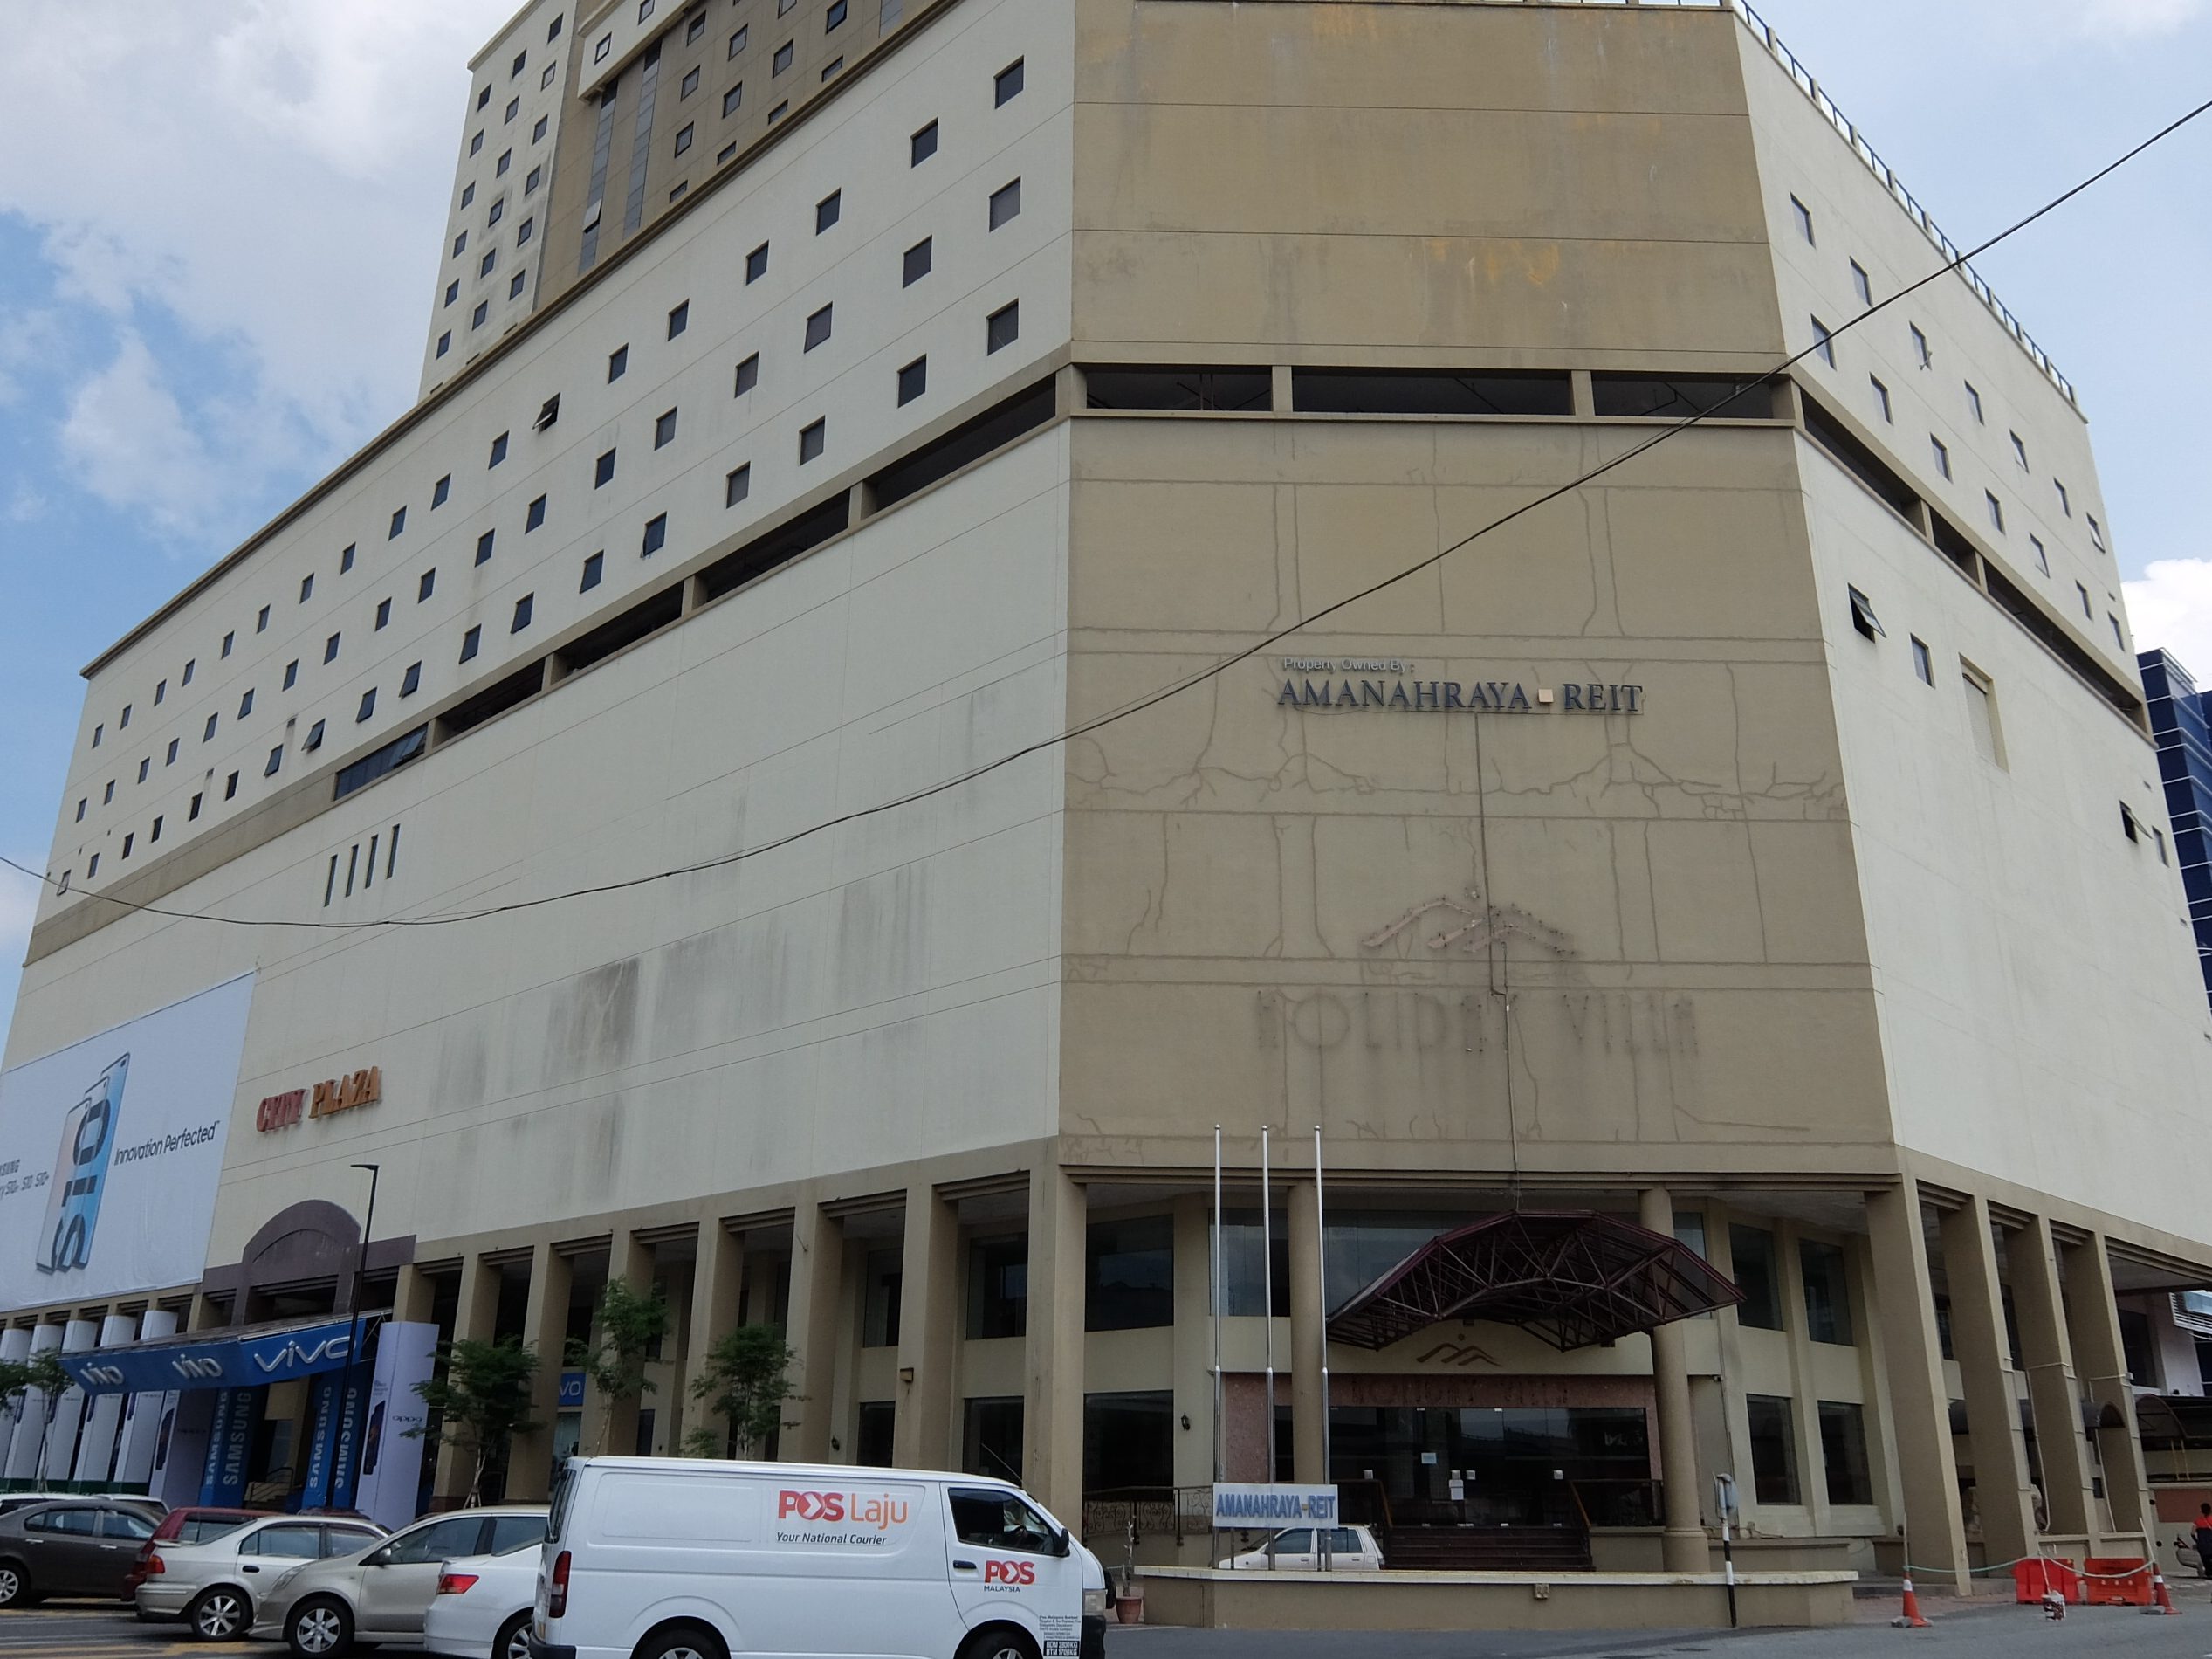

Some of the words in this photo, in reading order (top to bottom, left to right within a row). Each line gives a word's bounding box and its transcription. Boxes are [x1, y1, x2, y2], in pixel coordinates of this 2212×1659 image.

[1284, 657, 1336, 672] Property
[1341, 658, 1386, 671] Owned
[1391, 659, 1407, 672] By
[1277, 678, 1532, 709] AMANAHRAYA
[1562, 684, 1643, 712] REIT
[257, 1089, 307, 1132] CITY
[308, 1066, 379, 1119] PLAZA
[114, 1138, 163, 1166] Innovation
[254, 1340, 356, 1373] vivo
[223, 1392, 251, 1486] SAMSUNG
[309, 1386, 332, 1489] SAMSUNG
[778, 1490, 845, 1522] POS
[850, 1493, 908, 1530] Laju
[1216, 1494, 1302, 1518] AMANAHRAYA
[1308, 1495, 1335, 1518] REIT
[776, 1532, 800, 1543] Your
[801, 1532, 847, 1545] National
[849, 1534, 887, 1545] Courier
[984, 1559, 1035, 1585] POS
